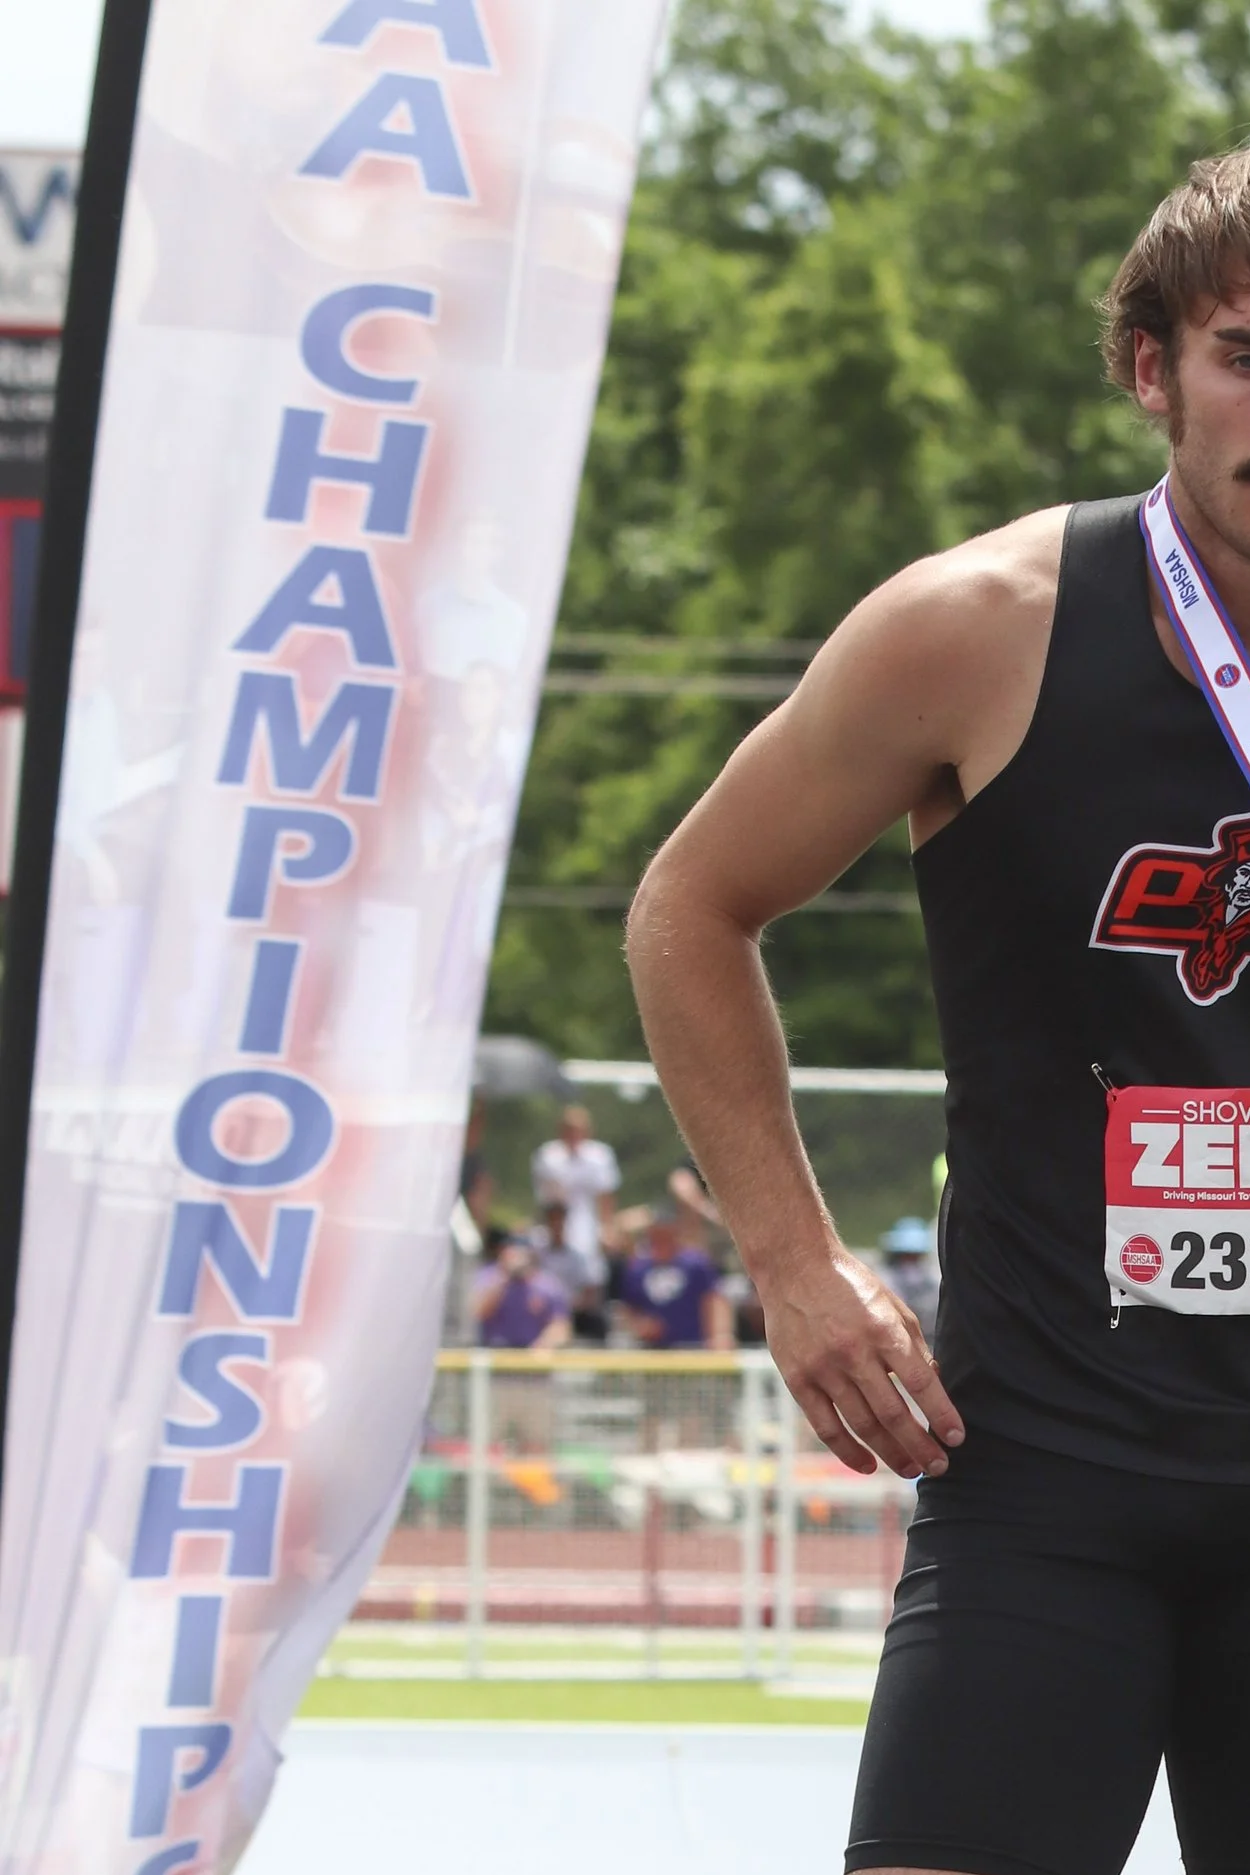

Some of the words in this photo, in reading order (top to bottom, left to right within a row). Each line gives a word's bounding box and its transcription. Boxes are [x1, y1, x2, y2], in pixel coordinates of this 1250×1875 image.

[1164, 549, 1199, 609] MSHSAA
[1162, 1190, 1195, 1202] Driving
[1196, 1191, 1236, 1201] Missouri
[1126, 1253, 1156, 1265] MSHSAA
